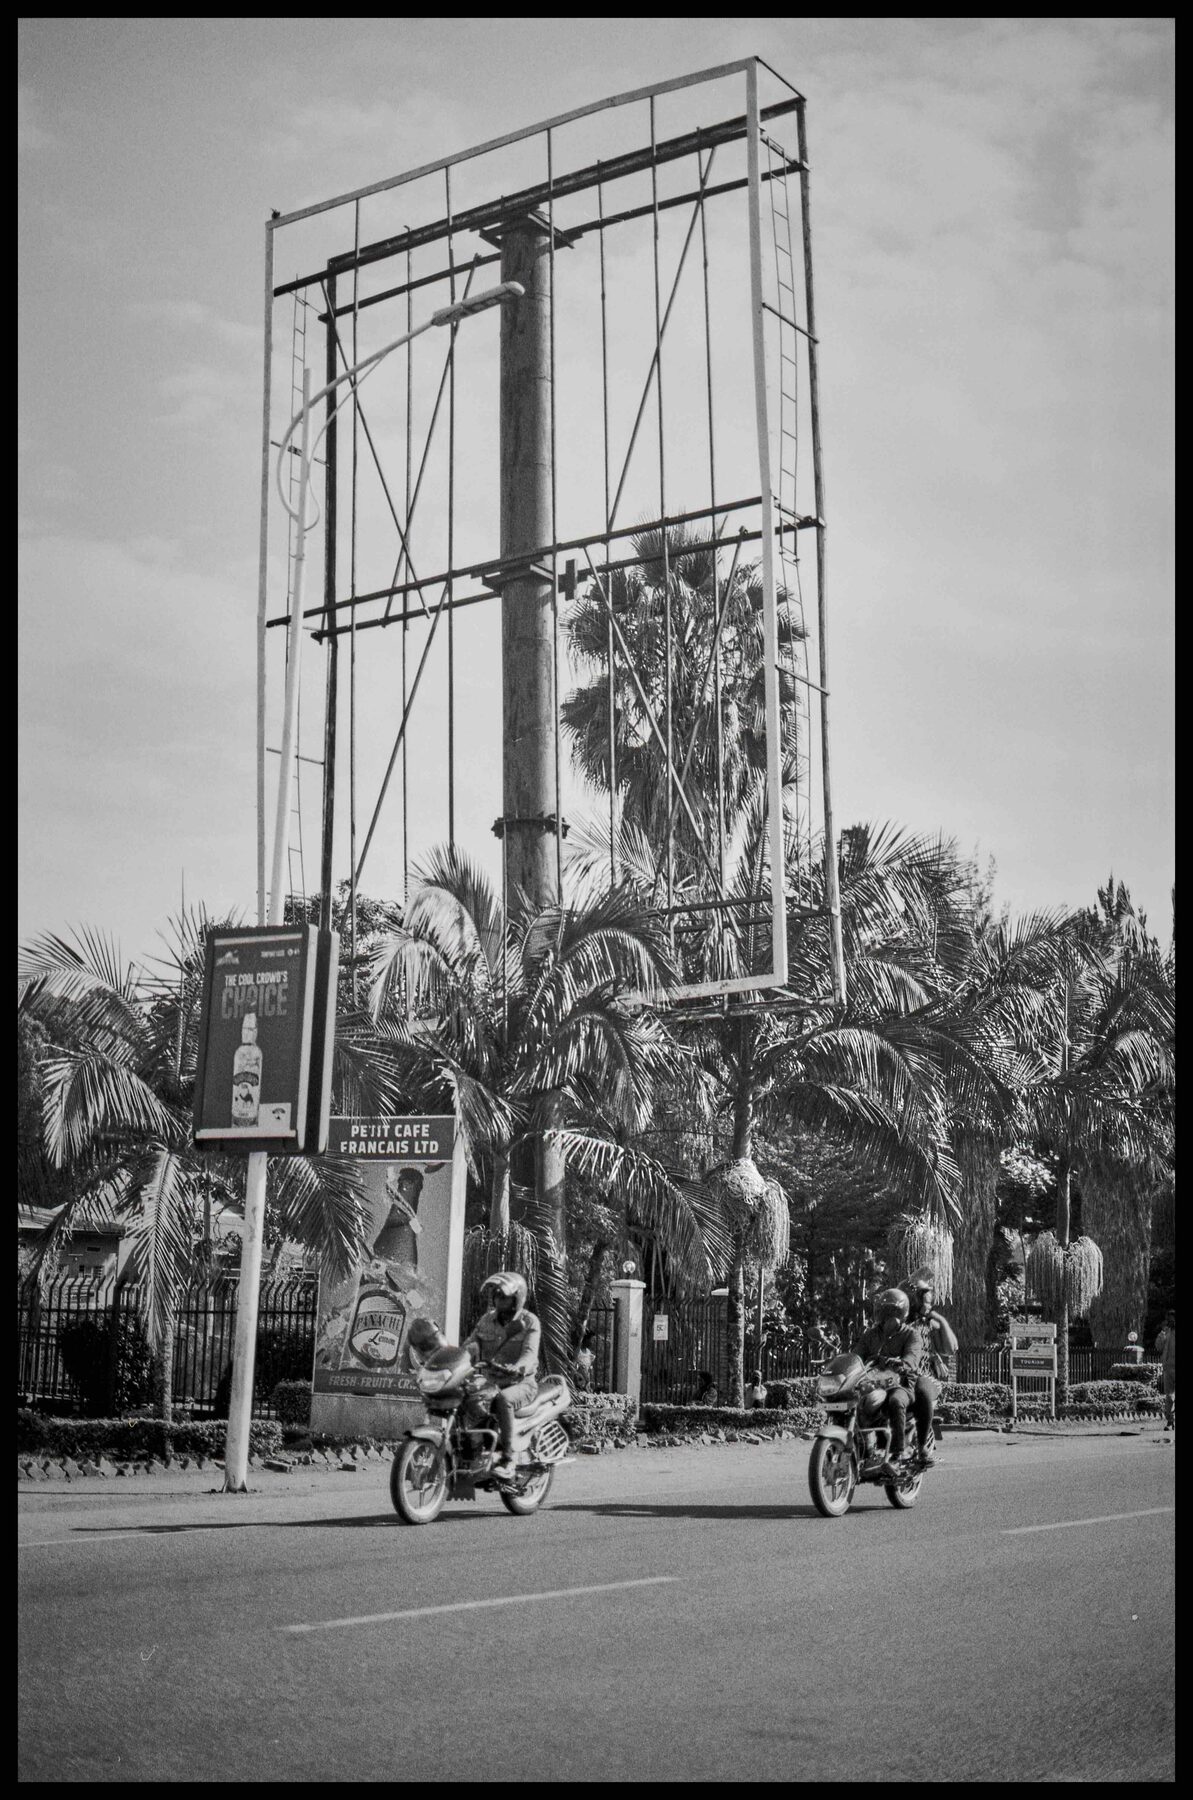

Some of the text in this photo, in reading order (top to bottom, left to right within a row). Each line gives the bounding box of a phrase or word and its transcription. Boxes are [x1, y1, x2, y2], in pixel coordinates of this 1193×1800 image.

[224, 970, 288, 987] THE COOL CROWD'S
[221, 984, 288, 1018] CHOICE
[351, 1124, 430, 1138] PETIT CAFE
[340, 1140, 439, 1154] FRANCAIS LTD
[361, 1377, 394, 1388] FRUITY
